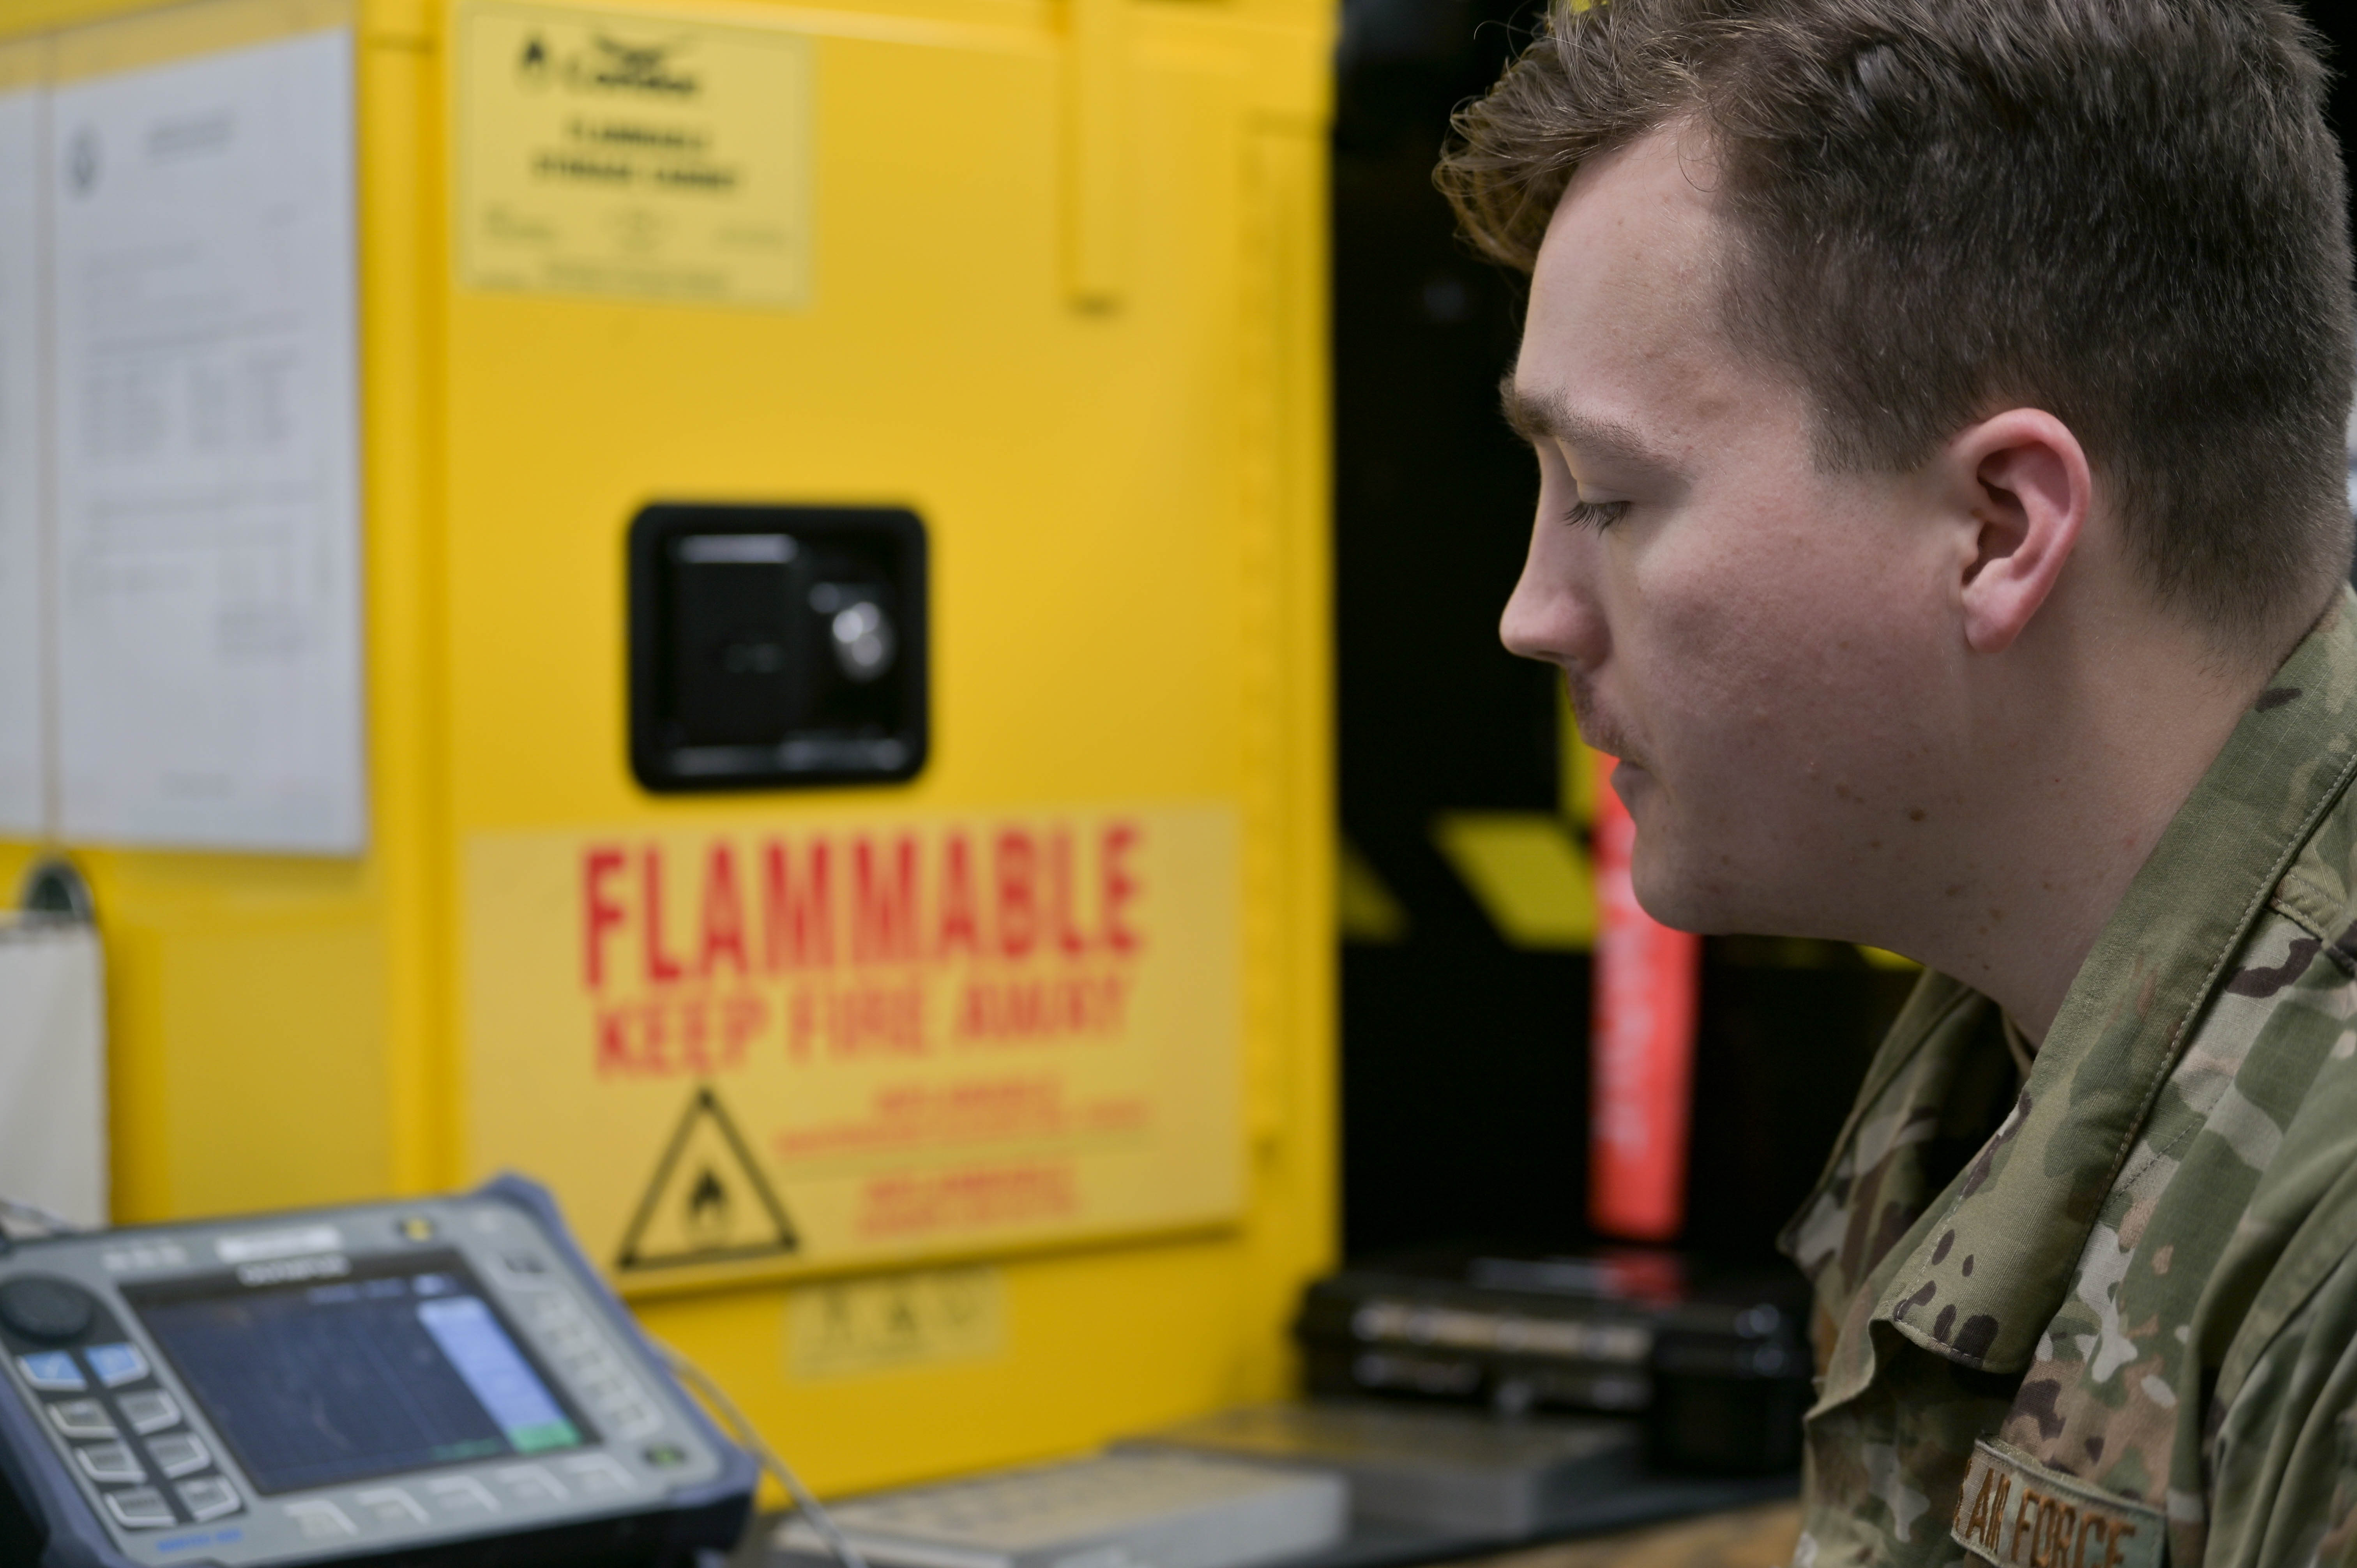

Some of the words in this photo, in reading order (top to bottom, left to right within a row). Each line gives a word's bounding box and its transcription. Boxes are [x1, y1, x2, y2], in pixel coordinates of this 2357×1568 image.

[581, 821, 1143, 991] FLAMMABLE
[595, 994, 772, 1076] KEEP
[789, 984, 929, 1061] FIRE
[955, 974, 1126, 1042] AWAY
[1966, 1467, 2011, 1556] AIR
[2011, 1488, 2136, 1568] FORCE
